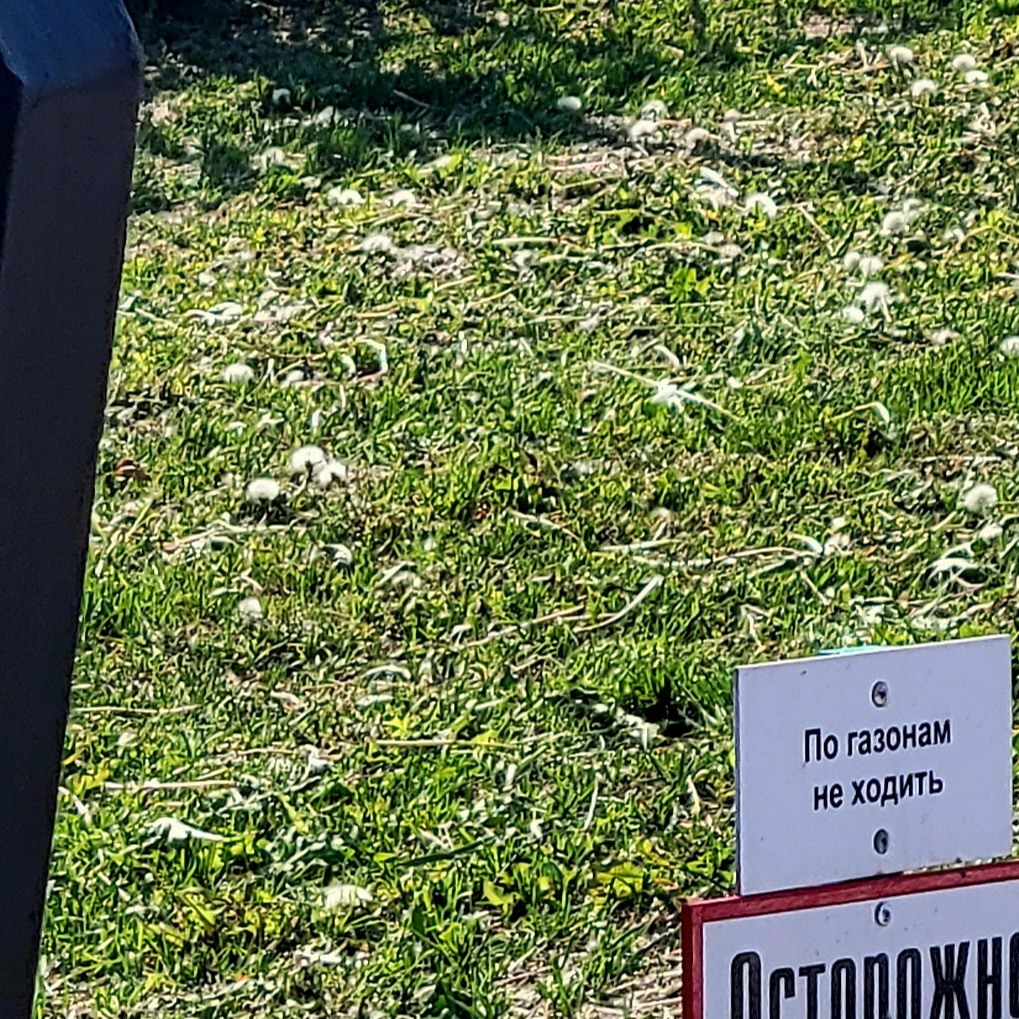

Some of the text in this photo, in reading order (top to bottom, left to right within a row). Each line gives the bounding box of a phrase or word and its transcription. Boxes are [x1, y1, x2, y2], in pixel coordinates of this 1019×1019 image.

[804, 718, 952, 763] По газонам
[813, 769, 944, 812] не ходить
